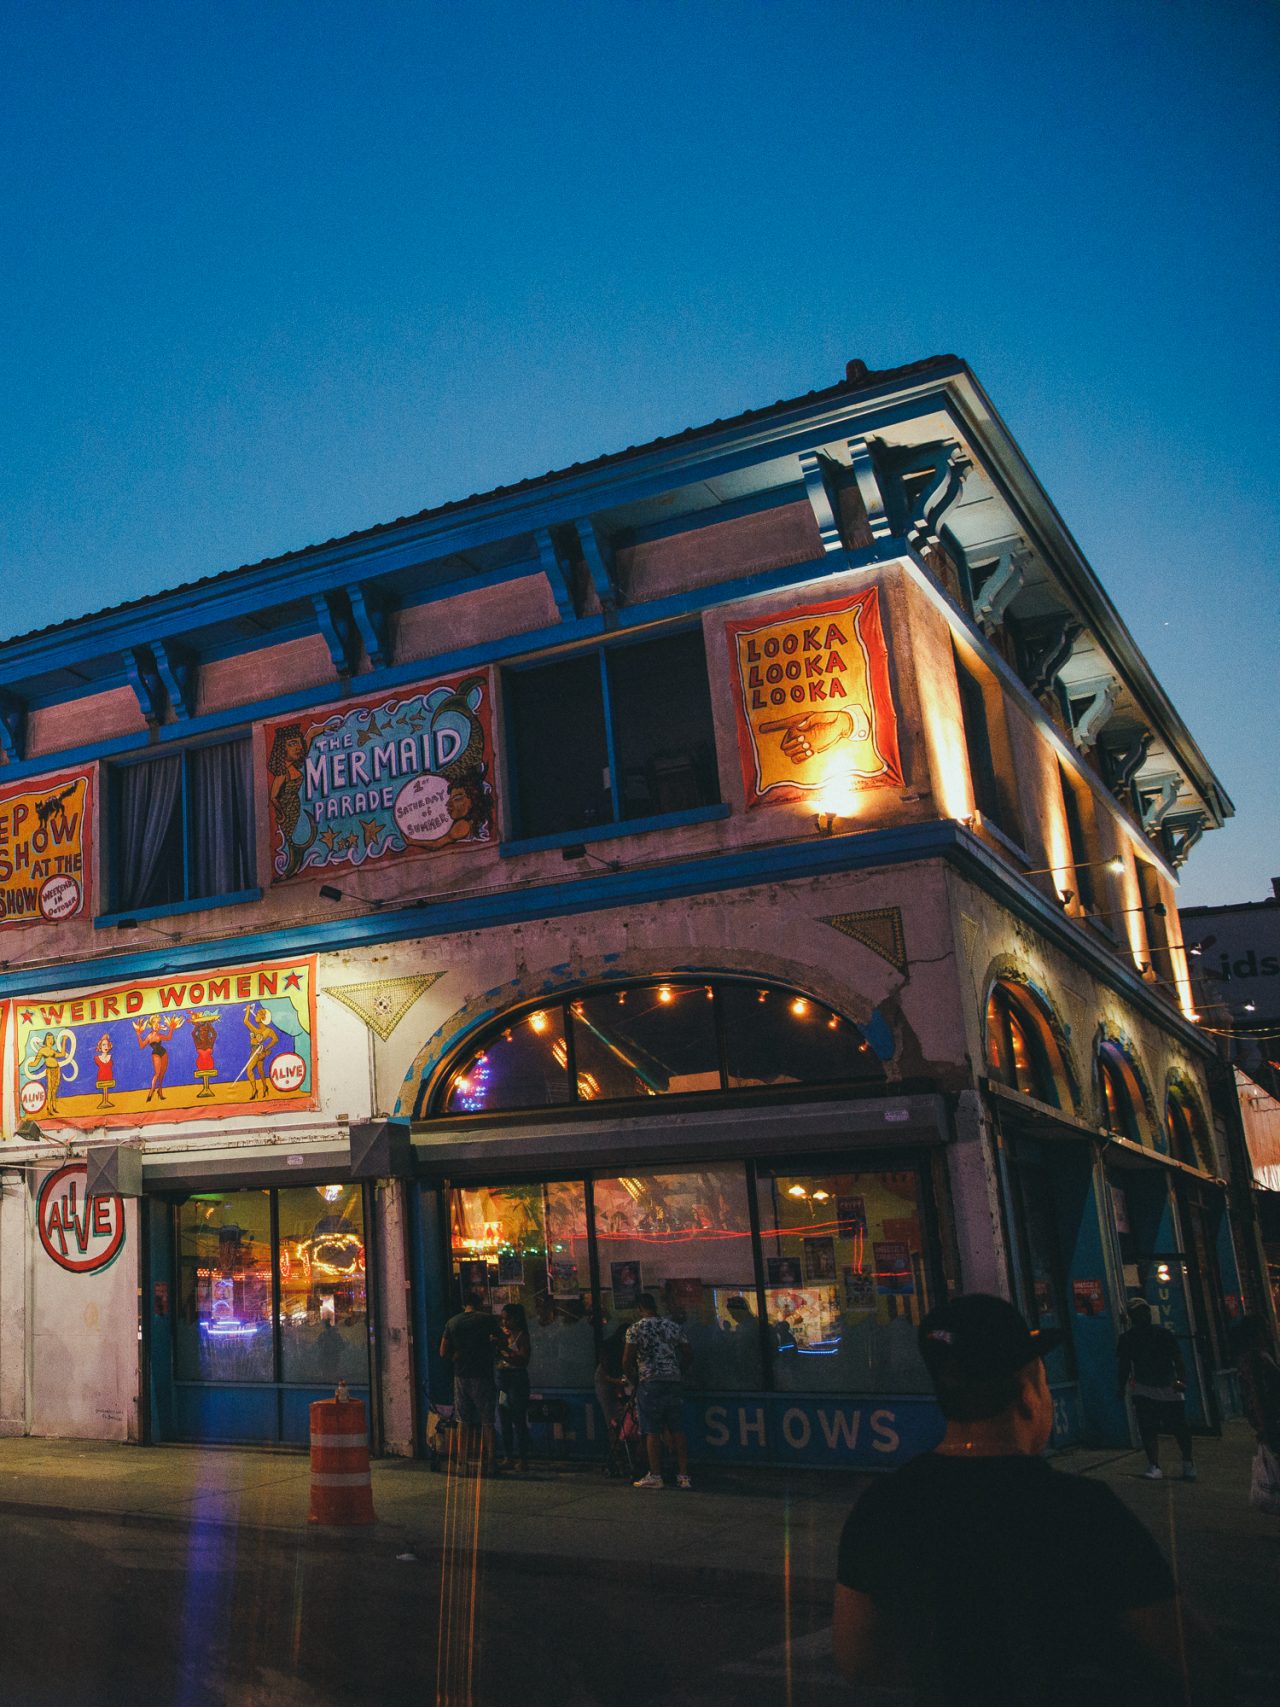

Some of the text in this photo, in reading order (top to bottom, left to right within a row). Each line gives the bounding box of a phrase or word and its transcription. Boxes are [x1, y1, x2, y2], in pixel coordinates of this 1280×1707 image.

[747, 623, 848, 663] LOOKA
[748, 651, 847, 688] LOOKA
[752, 677, 847, 710] LOOKA
[316, 732, 353, 752] THE
[304, 728, 462, 801] MERMAID
[314, 786, 395, 823] PARADE
[397, 789, 445, 819] SATURDAY
[407, 814, 449, 836] SUMMER
[31, 853, 82, 879] AT THE
[40, 972, 279, 1027] WEIRD WOMEN
[271, 1064, 303, 1080] ALIVE
[21, 1090, 46, 1103] ALIVE
[47, 1181, 112, 1256] ALIVE
[705, 1406, 901, 1454] SHOWS
